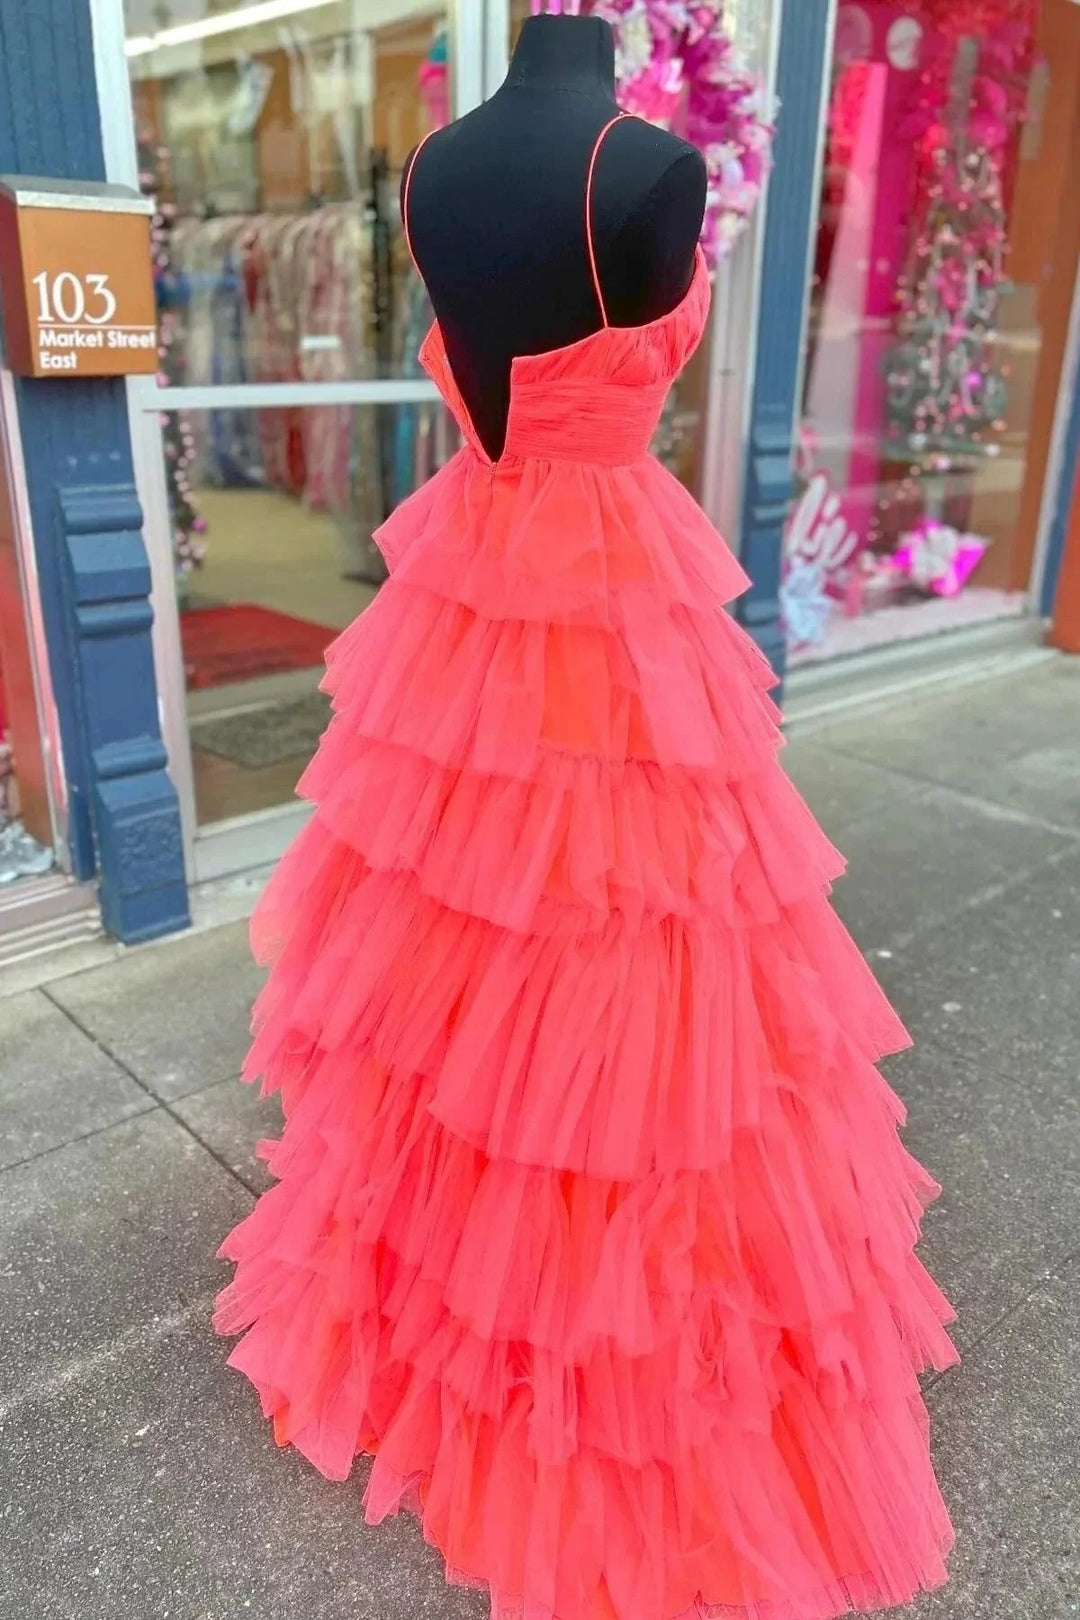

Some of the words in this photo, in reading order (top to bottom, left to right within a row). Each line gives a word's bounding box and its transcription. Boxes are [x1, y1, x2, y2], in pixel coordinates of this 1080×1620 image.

[32, 271, 116, 324] 103
[39, 329, 103, 348] Market
[107, 330, 156, 349] Street
[40, 351, 77, 369] East
